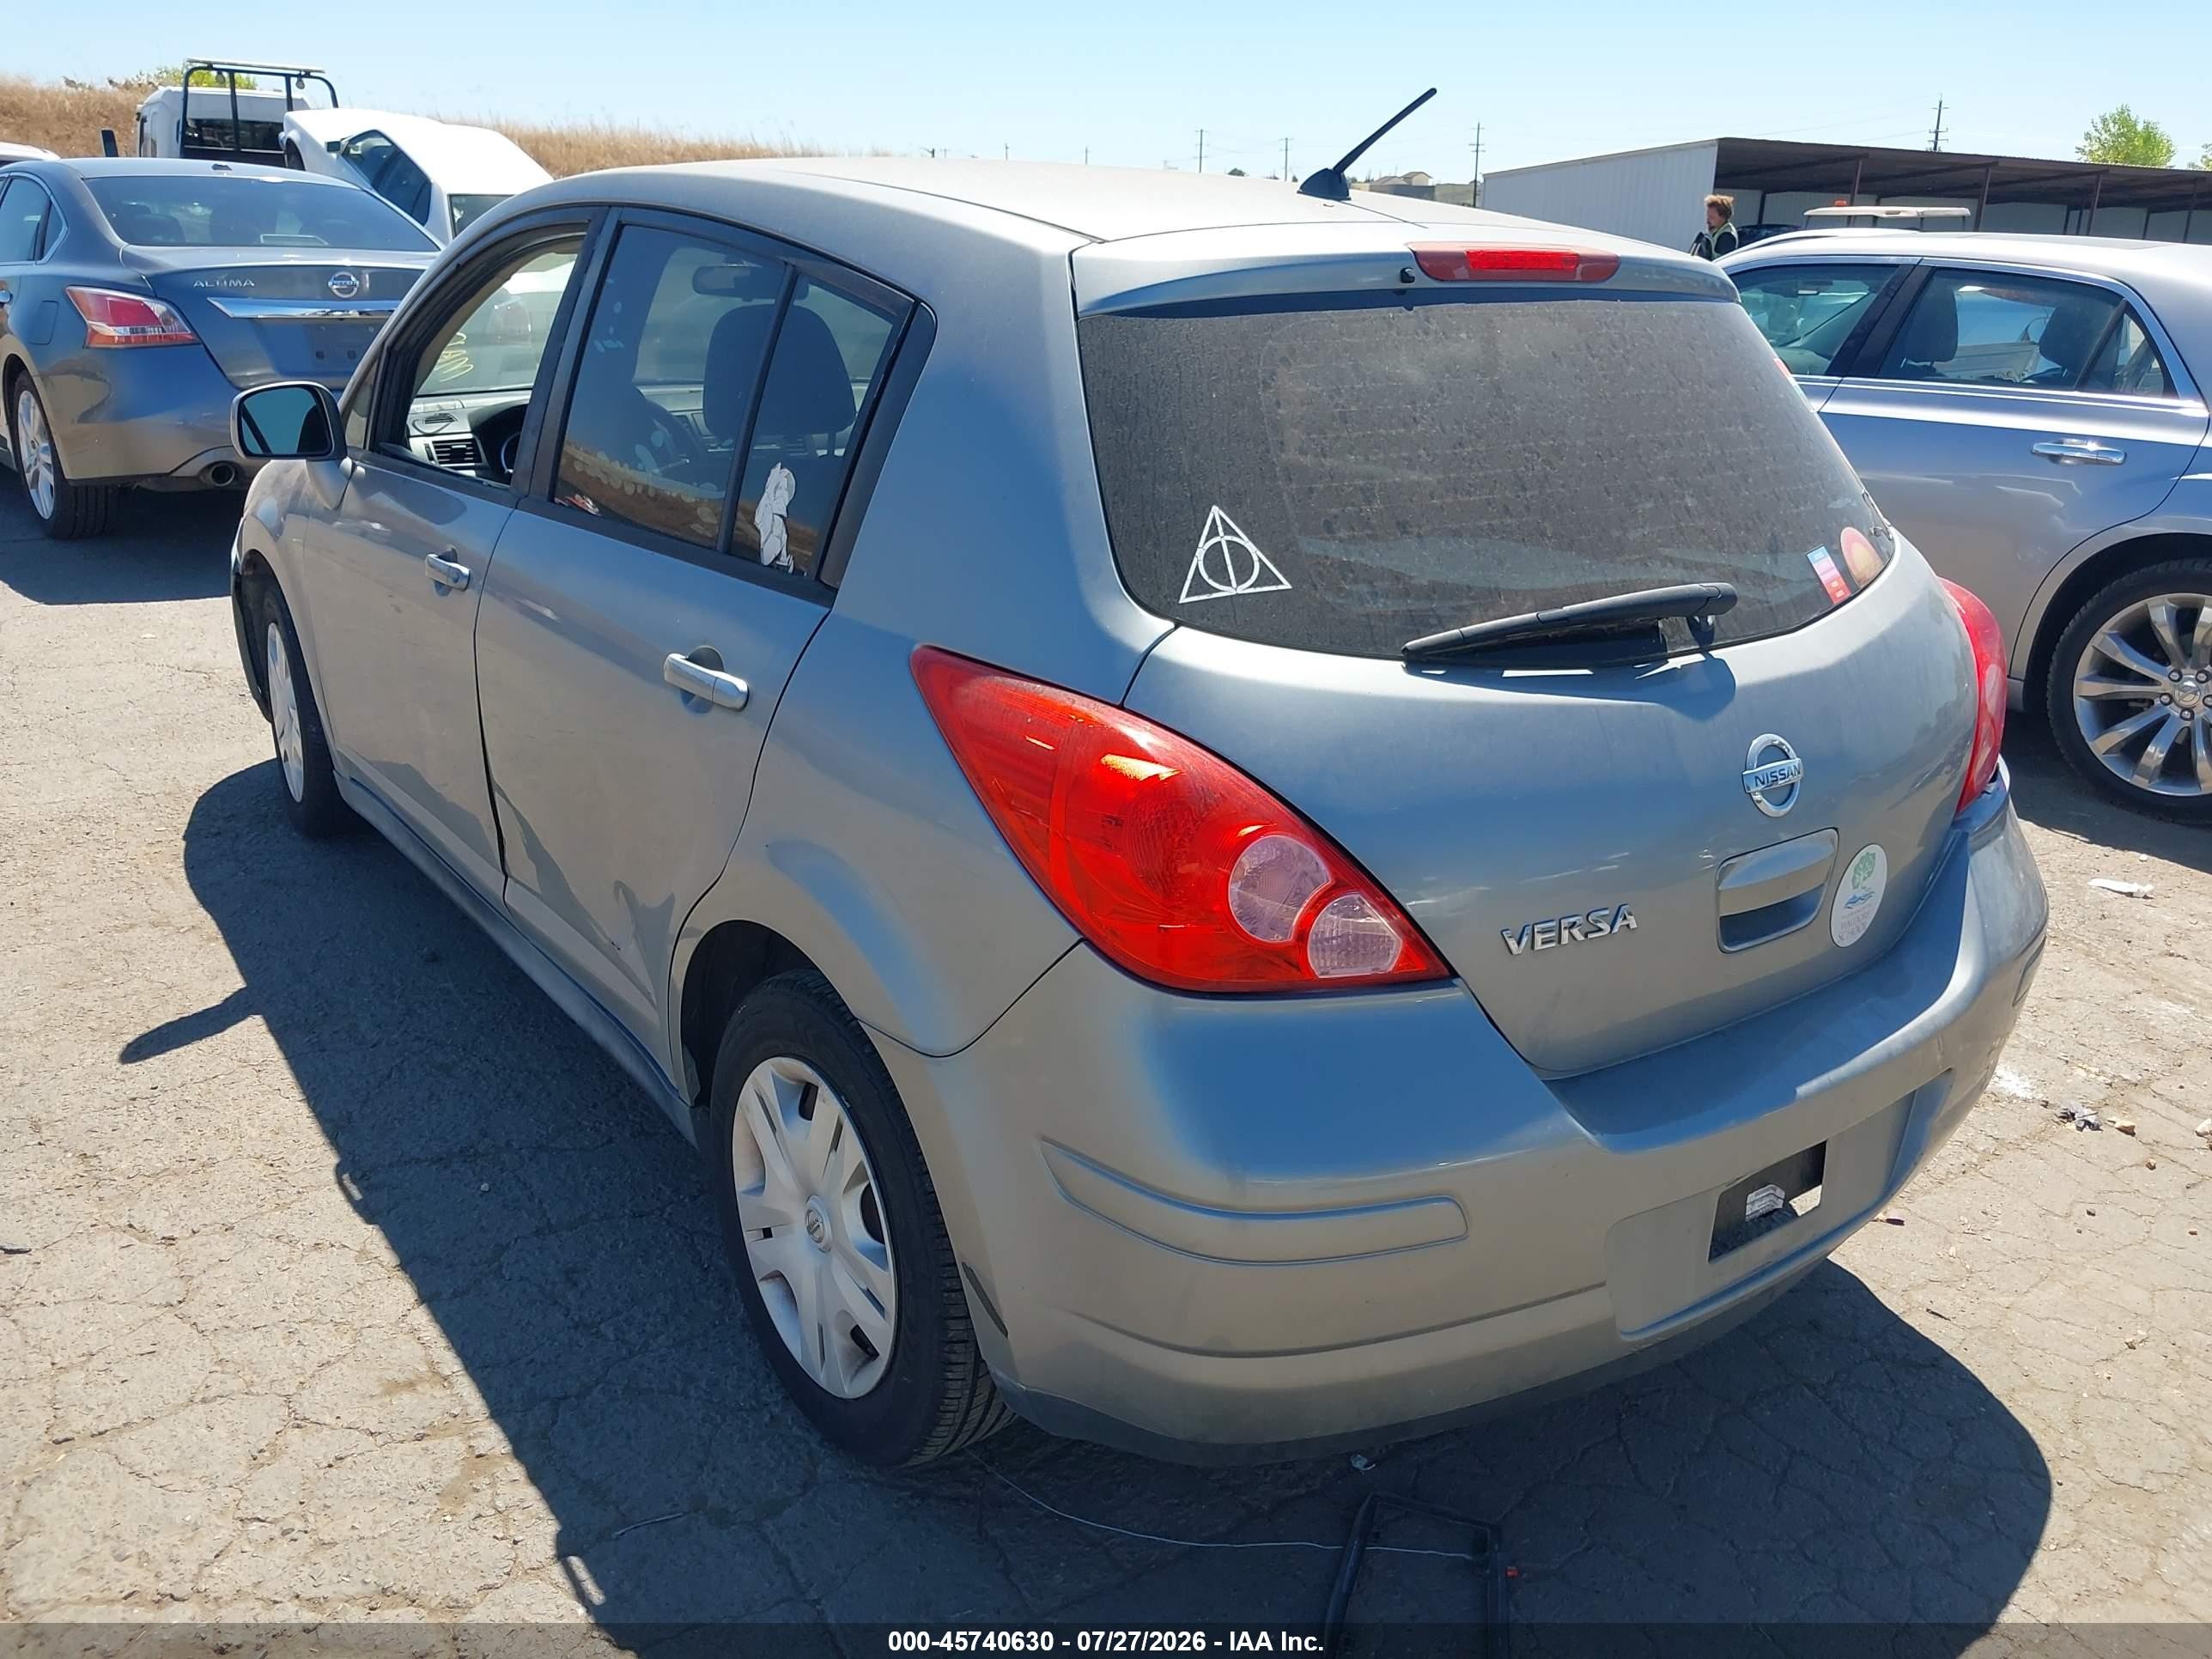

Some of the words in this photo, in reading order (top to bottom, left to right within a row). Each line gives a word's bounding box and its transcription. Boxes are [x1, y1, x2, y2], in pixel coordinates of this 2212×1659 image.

[193, 278, 255, 288] ALTIMA
[1753, 763, 1801, 787] NISSAN
[1501, 902, 1638, 956] VERSA
